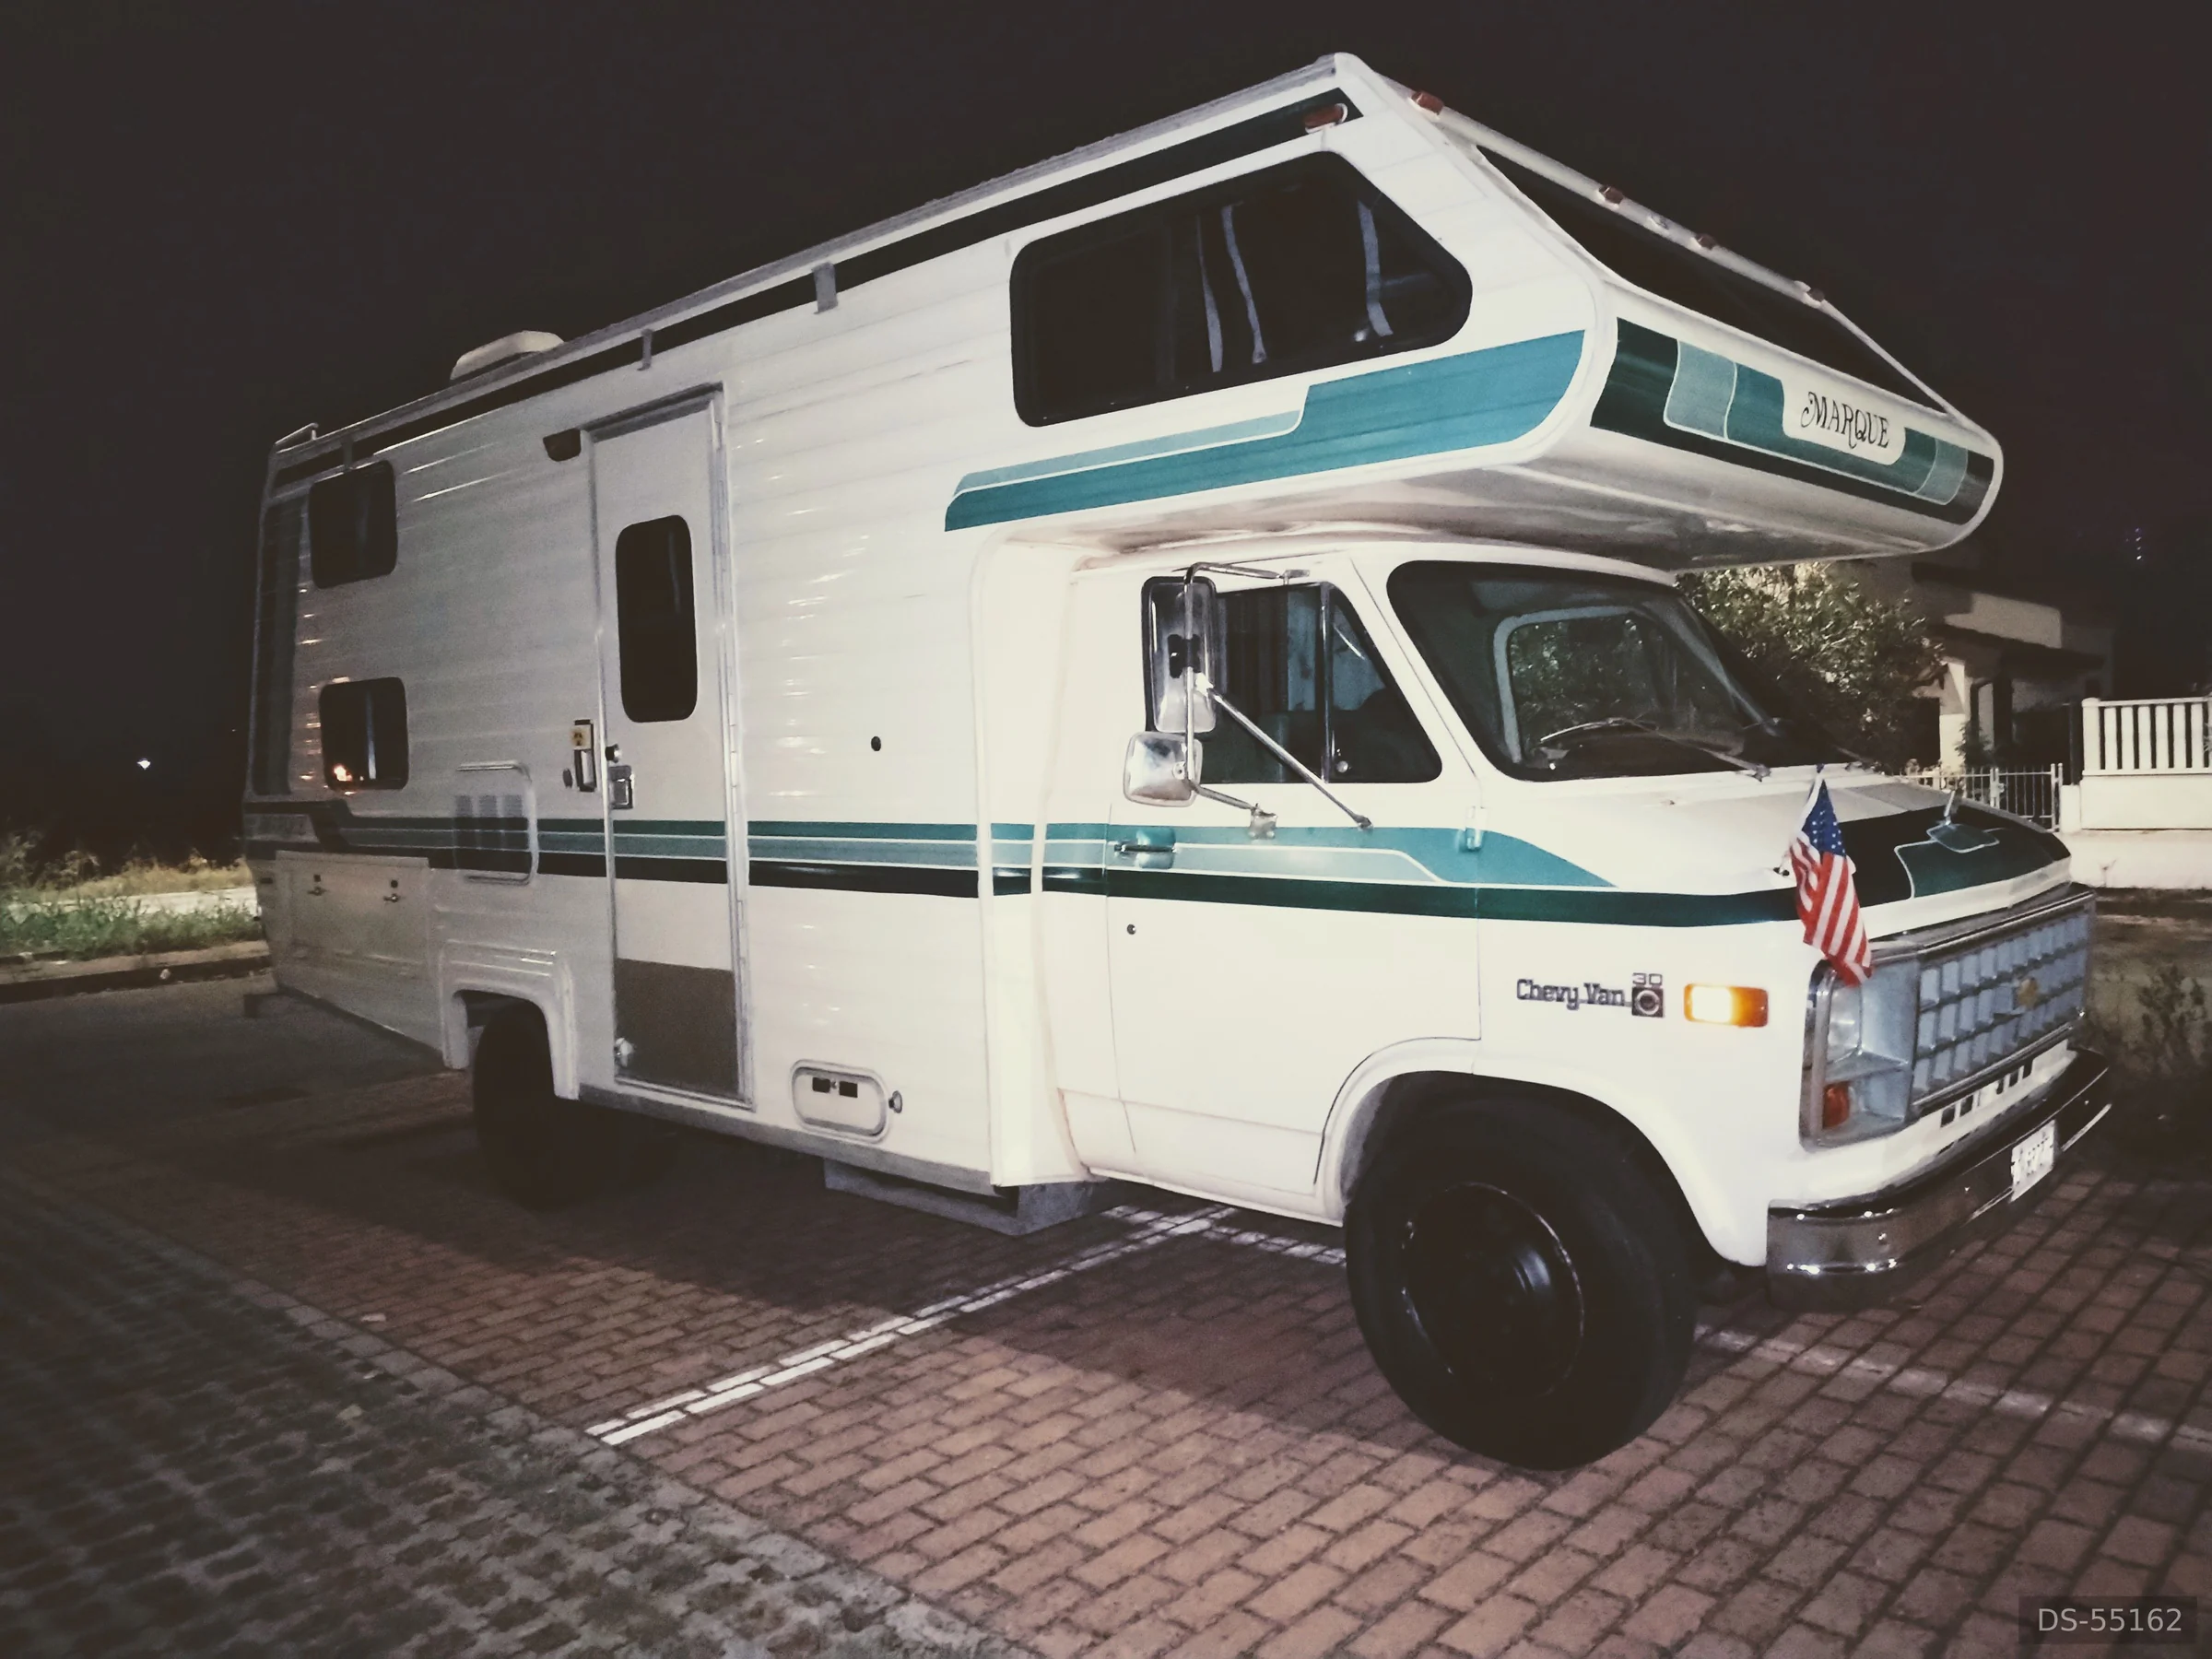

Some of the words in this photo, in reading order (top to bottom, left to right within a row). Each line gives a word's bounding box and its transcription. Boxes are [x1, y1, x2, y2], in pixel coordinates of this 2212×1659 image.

[1800, 391, 1889, 449] MARQUE
[1516, 979, 1579, 1010] Chevy
[1583, 982, 1625, 1006] Van
[1632, 972, 1663, 985] 30
